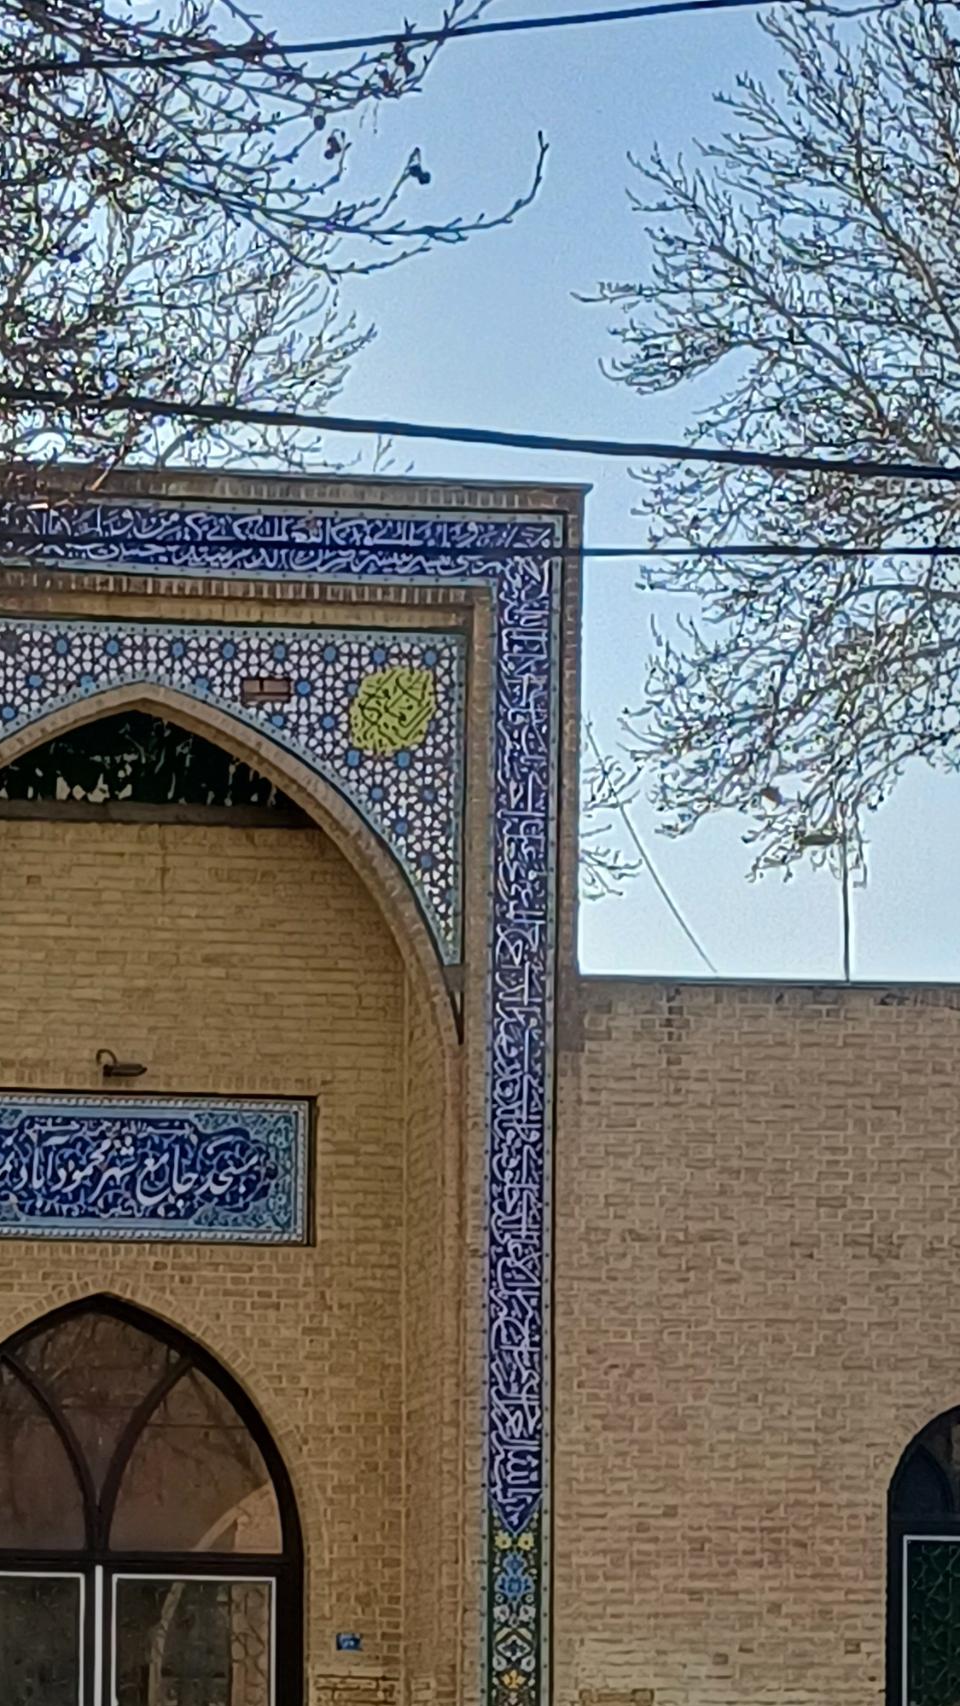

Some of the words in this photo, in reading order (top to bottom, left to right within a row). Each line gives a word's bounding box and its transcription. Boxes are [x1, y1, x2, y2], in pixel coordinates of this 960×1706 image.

[87, 1135, 139, 1203] شهر
[136, 1144, 199, 1208] جامع
[193, 1146, 259, 1197] مسجد
